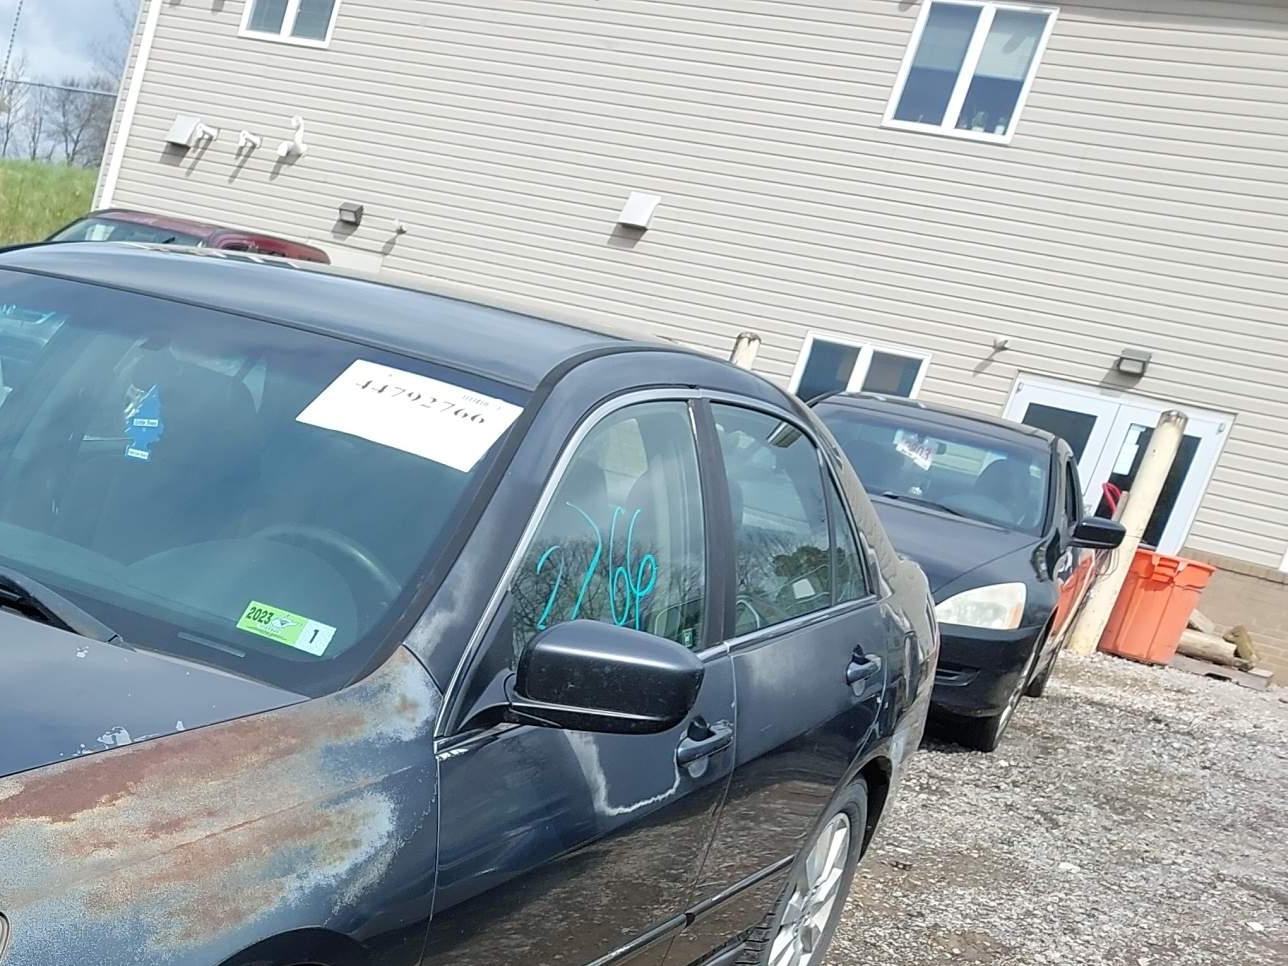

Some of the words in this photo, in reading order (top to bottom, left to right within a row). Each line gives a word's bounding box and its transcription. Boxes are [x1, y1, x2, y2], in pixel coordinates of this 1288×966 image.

[355, 379, 485, 424] 44792766
[246, 606, 275, 625] 2023
[308, 629, 320, 644] 1
